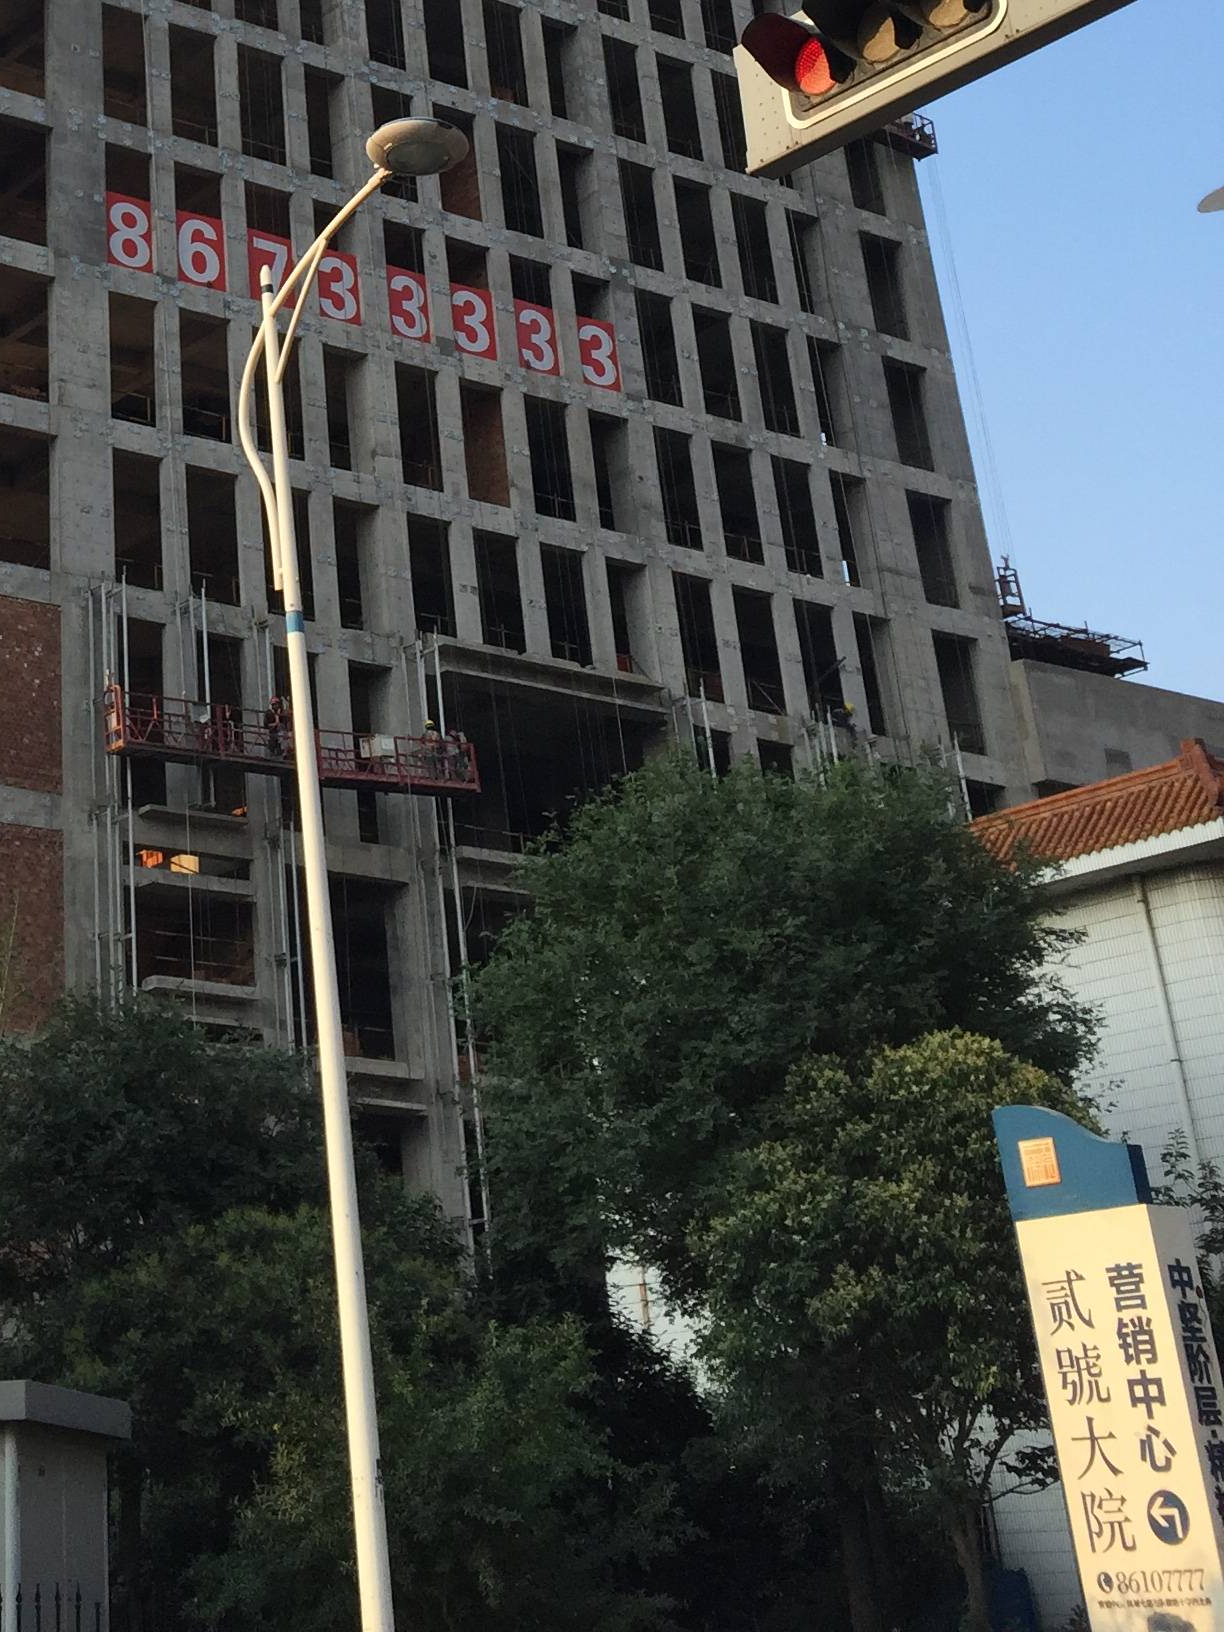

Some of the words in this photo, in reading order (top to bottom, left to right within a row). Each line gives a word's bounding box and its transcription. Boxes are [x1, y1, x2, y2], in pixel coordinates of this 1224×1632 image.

[106, 196, 621, 390] 86733333
[1041, 1267, 1138, 1556] 贰號大院
[1104, 1261, 1177, 1474] 营销中心
[1115, 1568, 1205, 1595] 86107777
